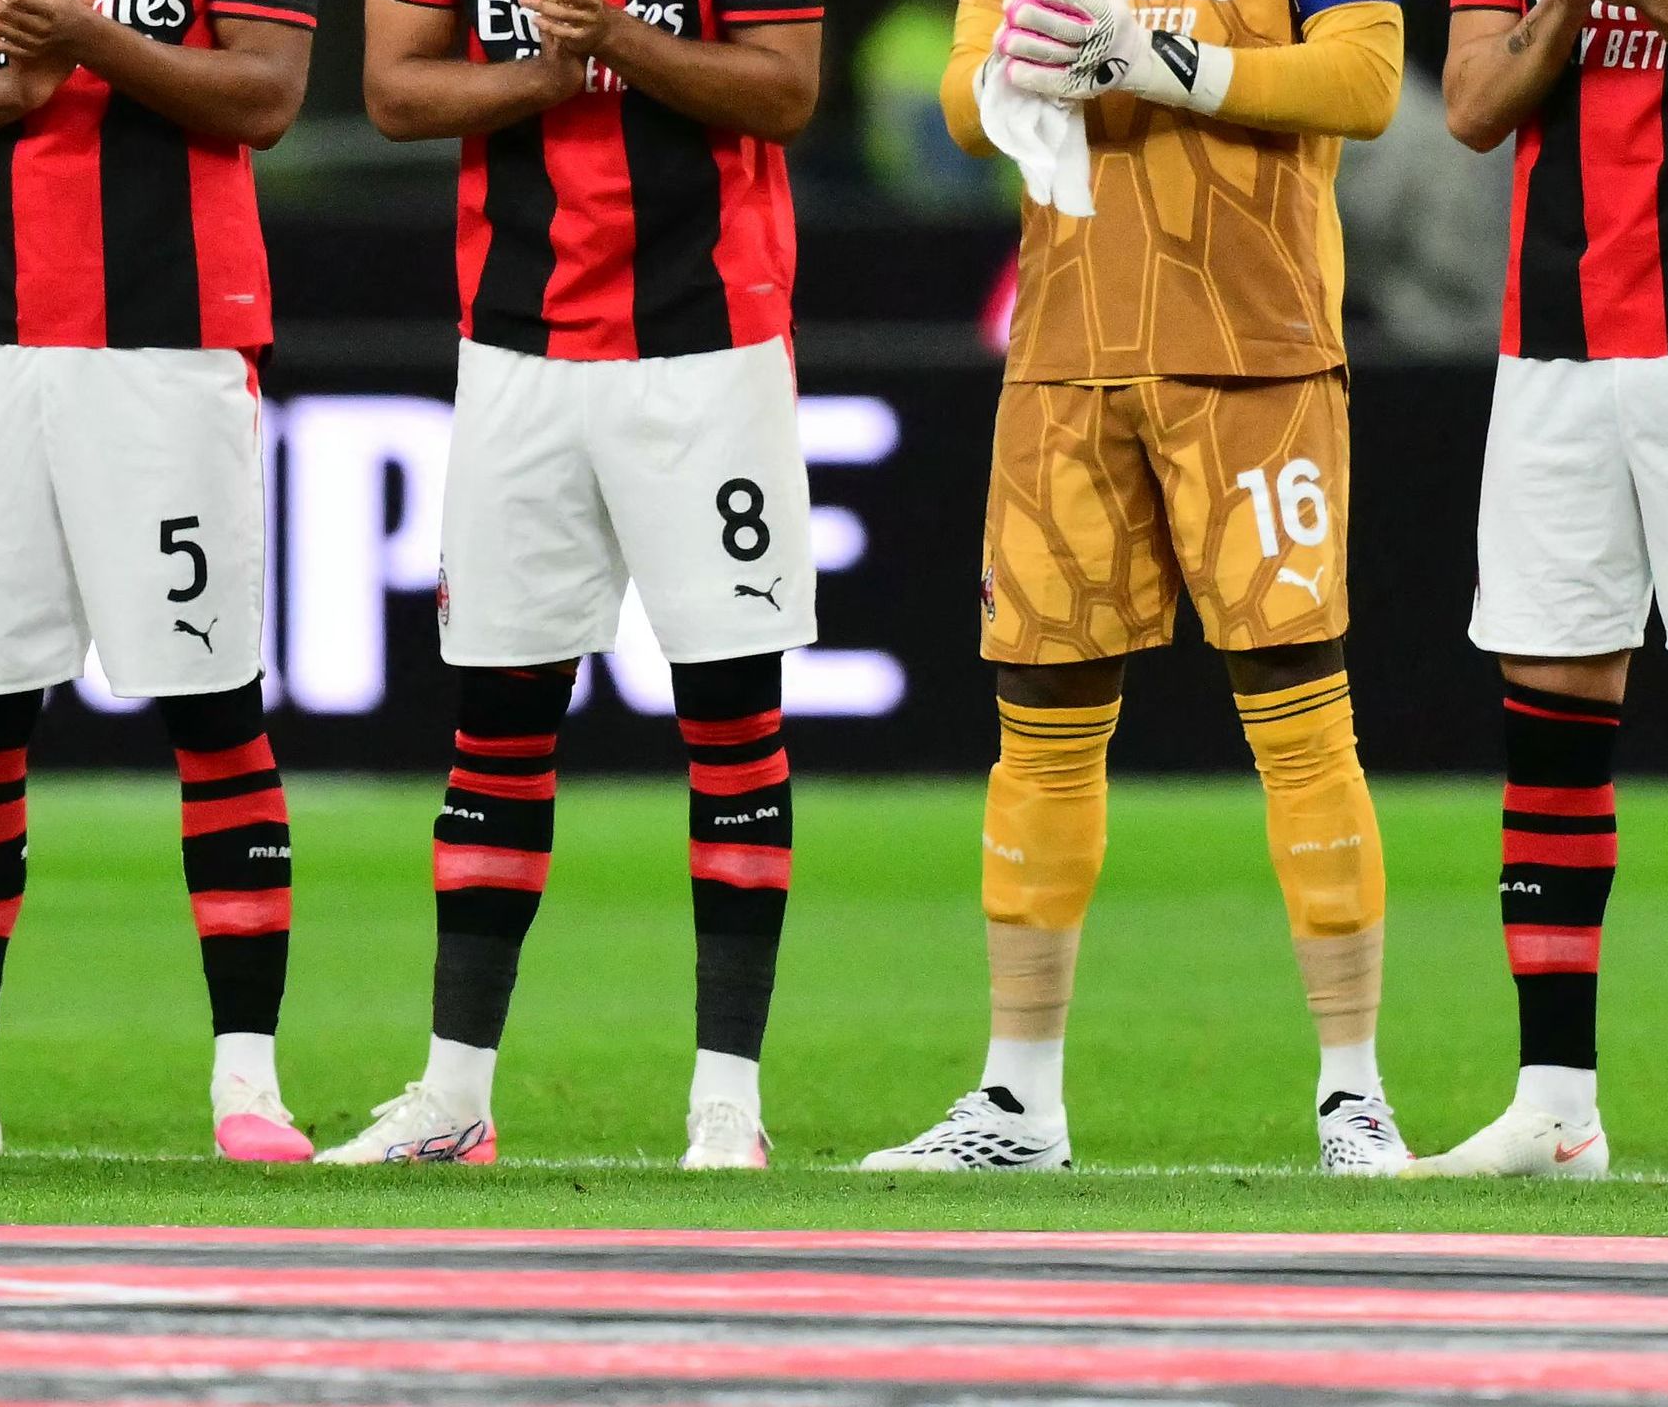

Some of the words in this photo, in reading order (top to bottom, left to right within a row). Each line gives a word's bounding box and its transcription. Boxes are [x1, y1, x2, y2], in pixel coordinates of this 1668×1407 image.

[1131, 6, 1198, 38] TTER
[715, 477, 771, 562] 8
[1236, 458, 1329, 558] 16
[159, 515, 208, 603] 5
